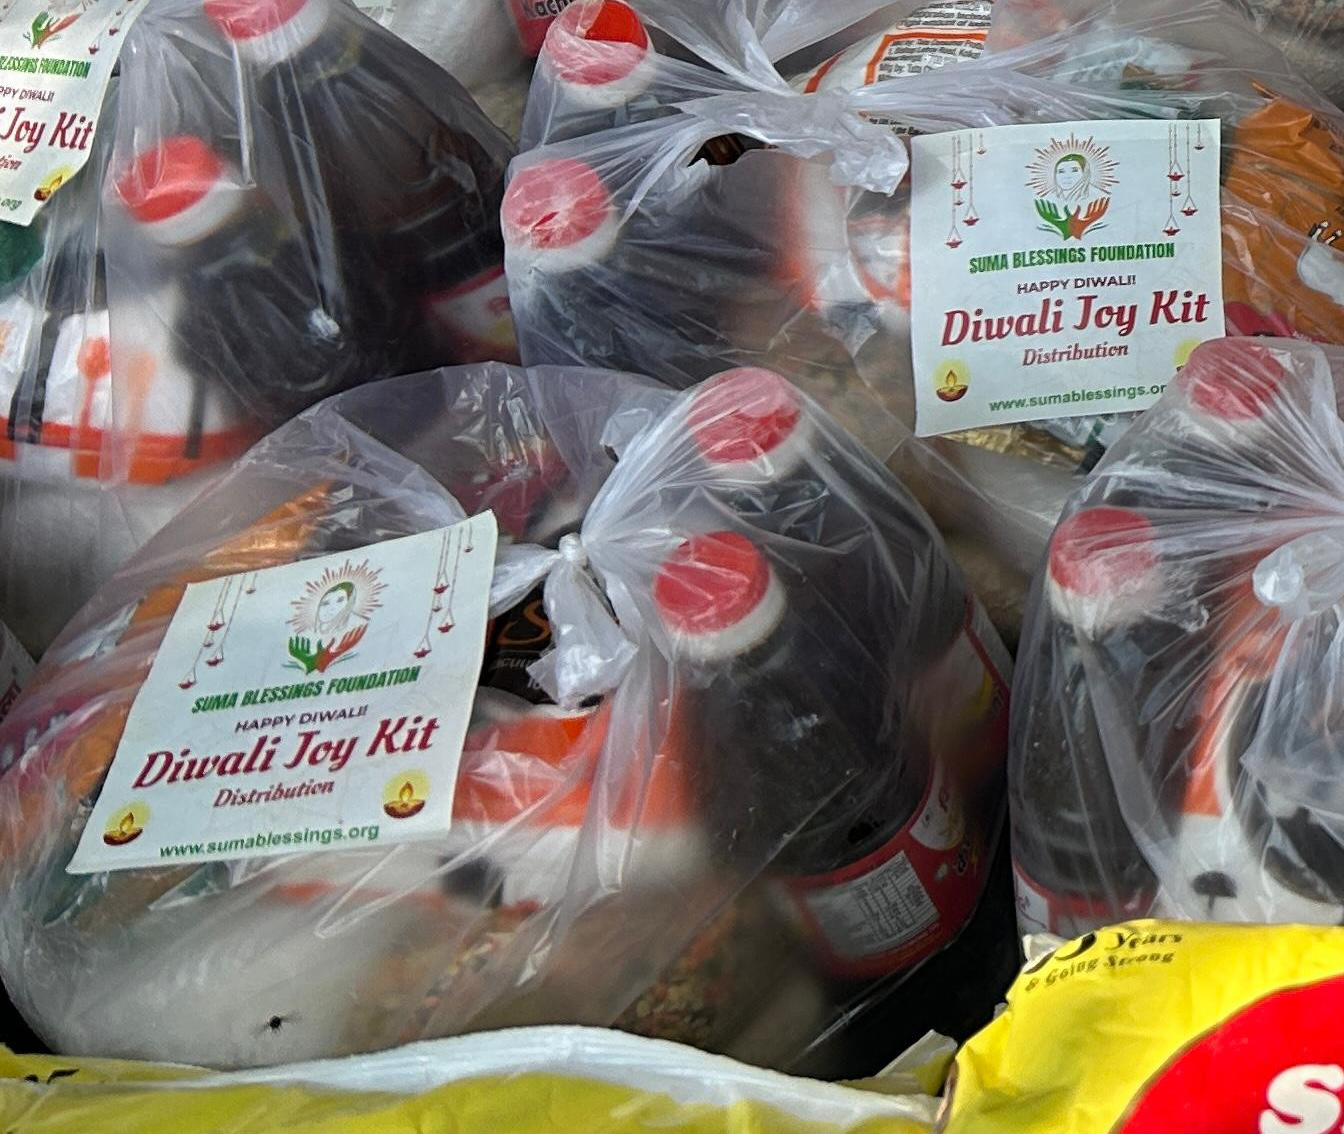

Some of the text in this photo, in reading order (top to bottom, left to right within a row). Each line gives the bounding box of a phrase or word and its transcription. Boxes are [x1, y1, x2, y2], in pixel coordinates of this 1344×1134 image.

[0, 107, 93, 153] Joy Kit
[969, 243, 1174, 274] SUMA BLESSINGS FOUNDATION
[1017, 274, 1135, 294] HAPPY DIWALI!
[942, 290, 1209, 347] Diwali Joy Kit
[1023, 342, 1128, 365] Distribution
[191, 665, 421, 714] SUMA BLESSINGS FOUNDATION
[131, 715, 438, 788] Diwali Joy Kit
[213, 779, 336, 807] Distribution
[160, 826, 377, 857] www.sumablessings.org
